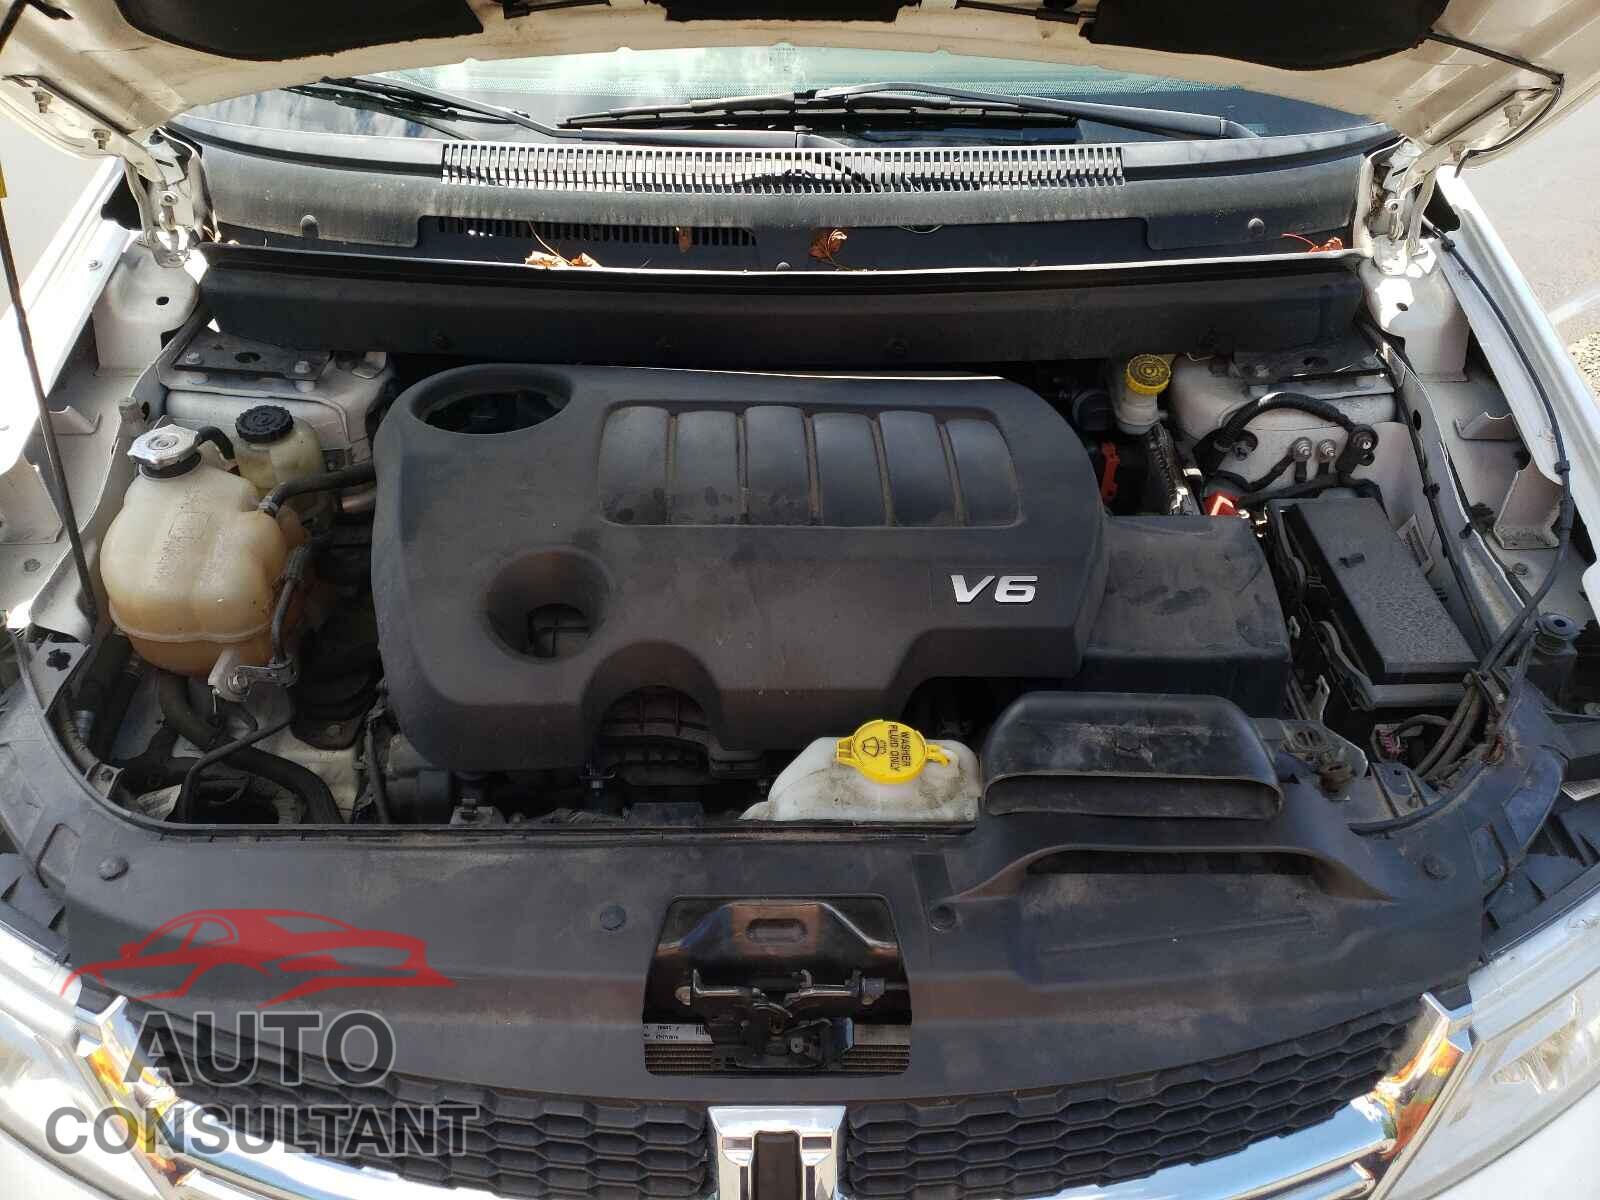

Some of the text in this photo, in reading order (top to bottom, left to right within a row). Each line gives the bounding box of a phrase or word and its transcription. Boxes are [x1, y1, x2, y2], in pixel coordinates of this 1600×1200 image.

[951, 574, 1038, 603] V6
[888, 724, 900, 772] FLUID ONLY
[900, 731, 911, 767] WASHER
